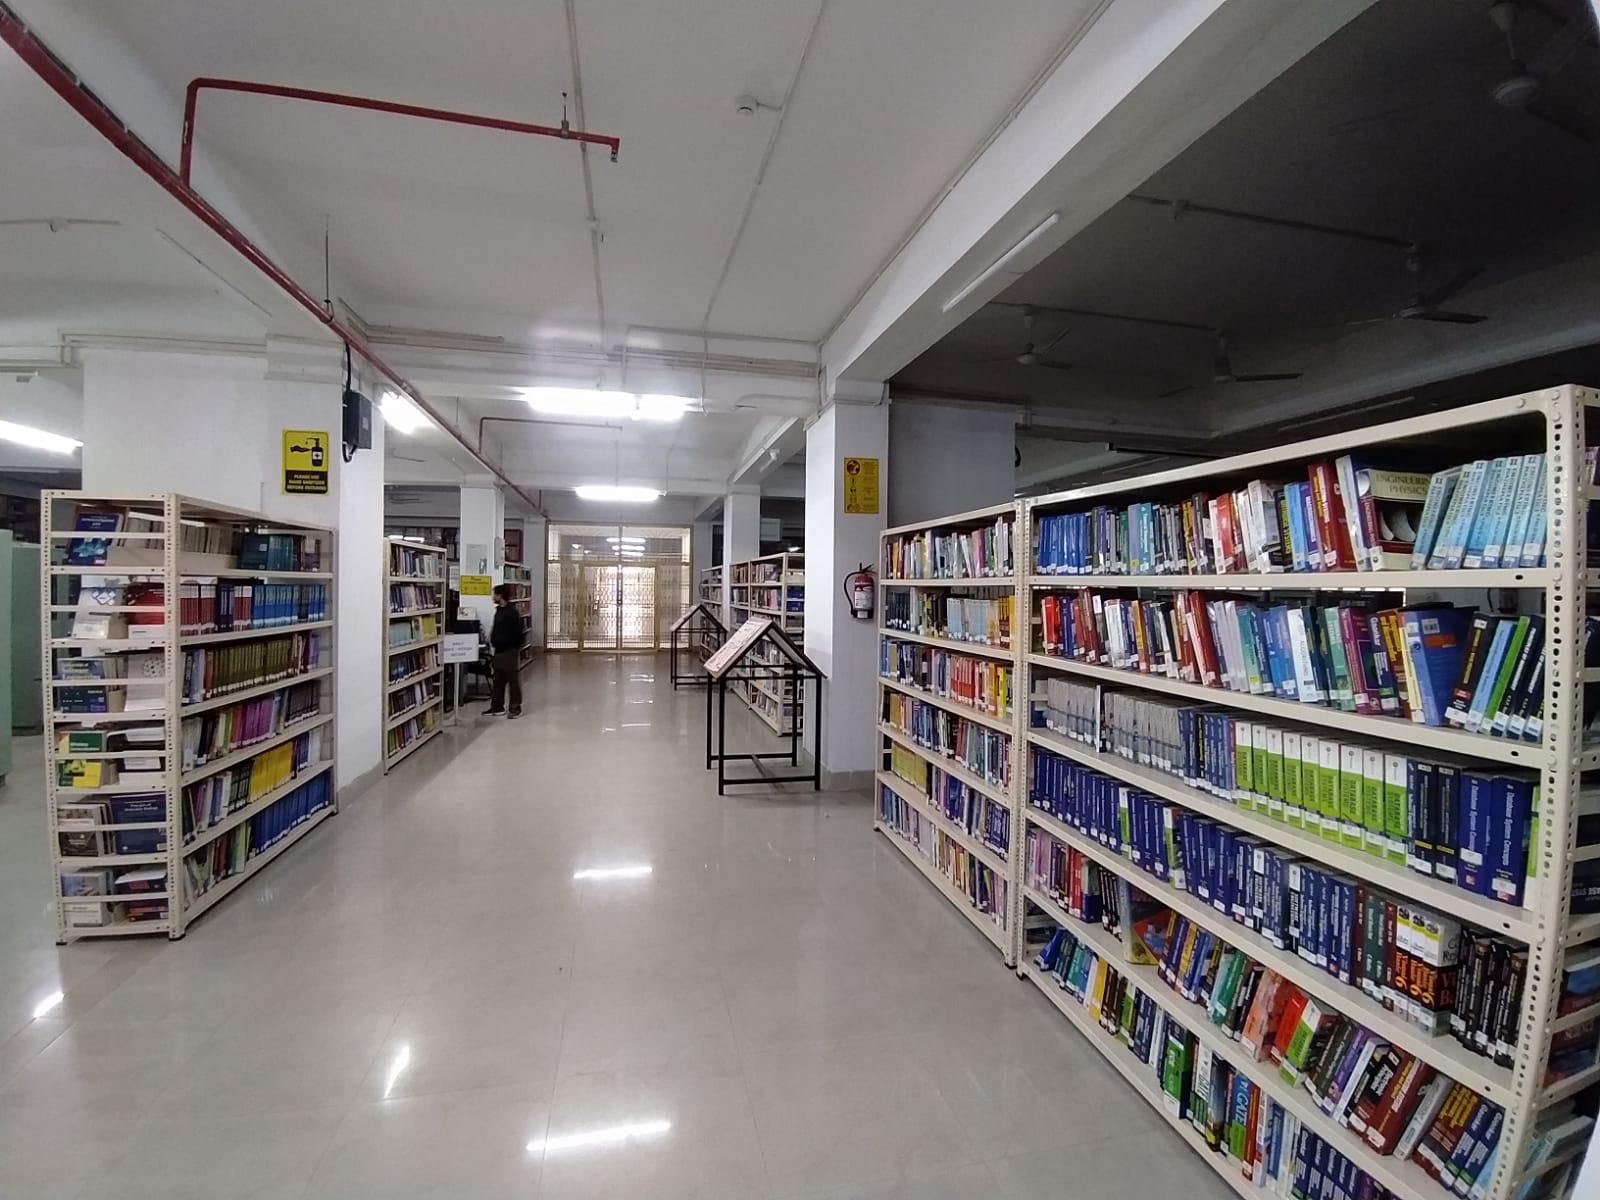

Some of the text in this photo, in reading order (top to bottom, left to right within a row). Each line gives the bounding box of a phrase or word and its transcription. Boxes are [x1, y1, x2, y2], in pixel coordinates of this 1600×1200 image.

[1376, 474, 1430, 484] ENGINEERIN
[1502, 792, 1514, 866] Database System Concepts
[1395, 976, 1407, 991] 6
[1410, 983, 1422, 996] 6
[1422, 992, 1434, 1008] 6
[1236, 1092, 1248, 1126] GATE
